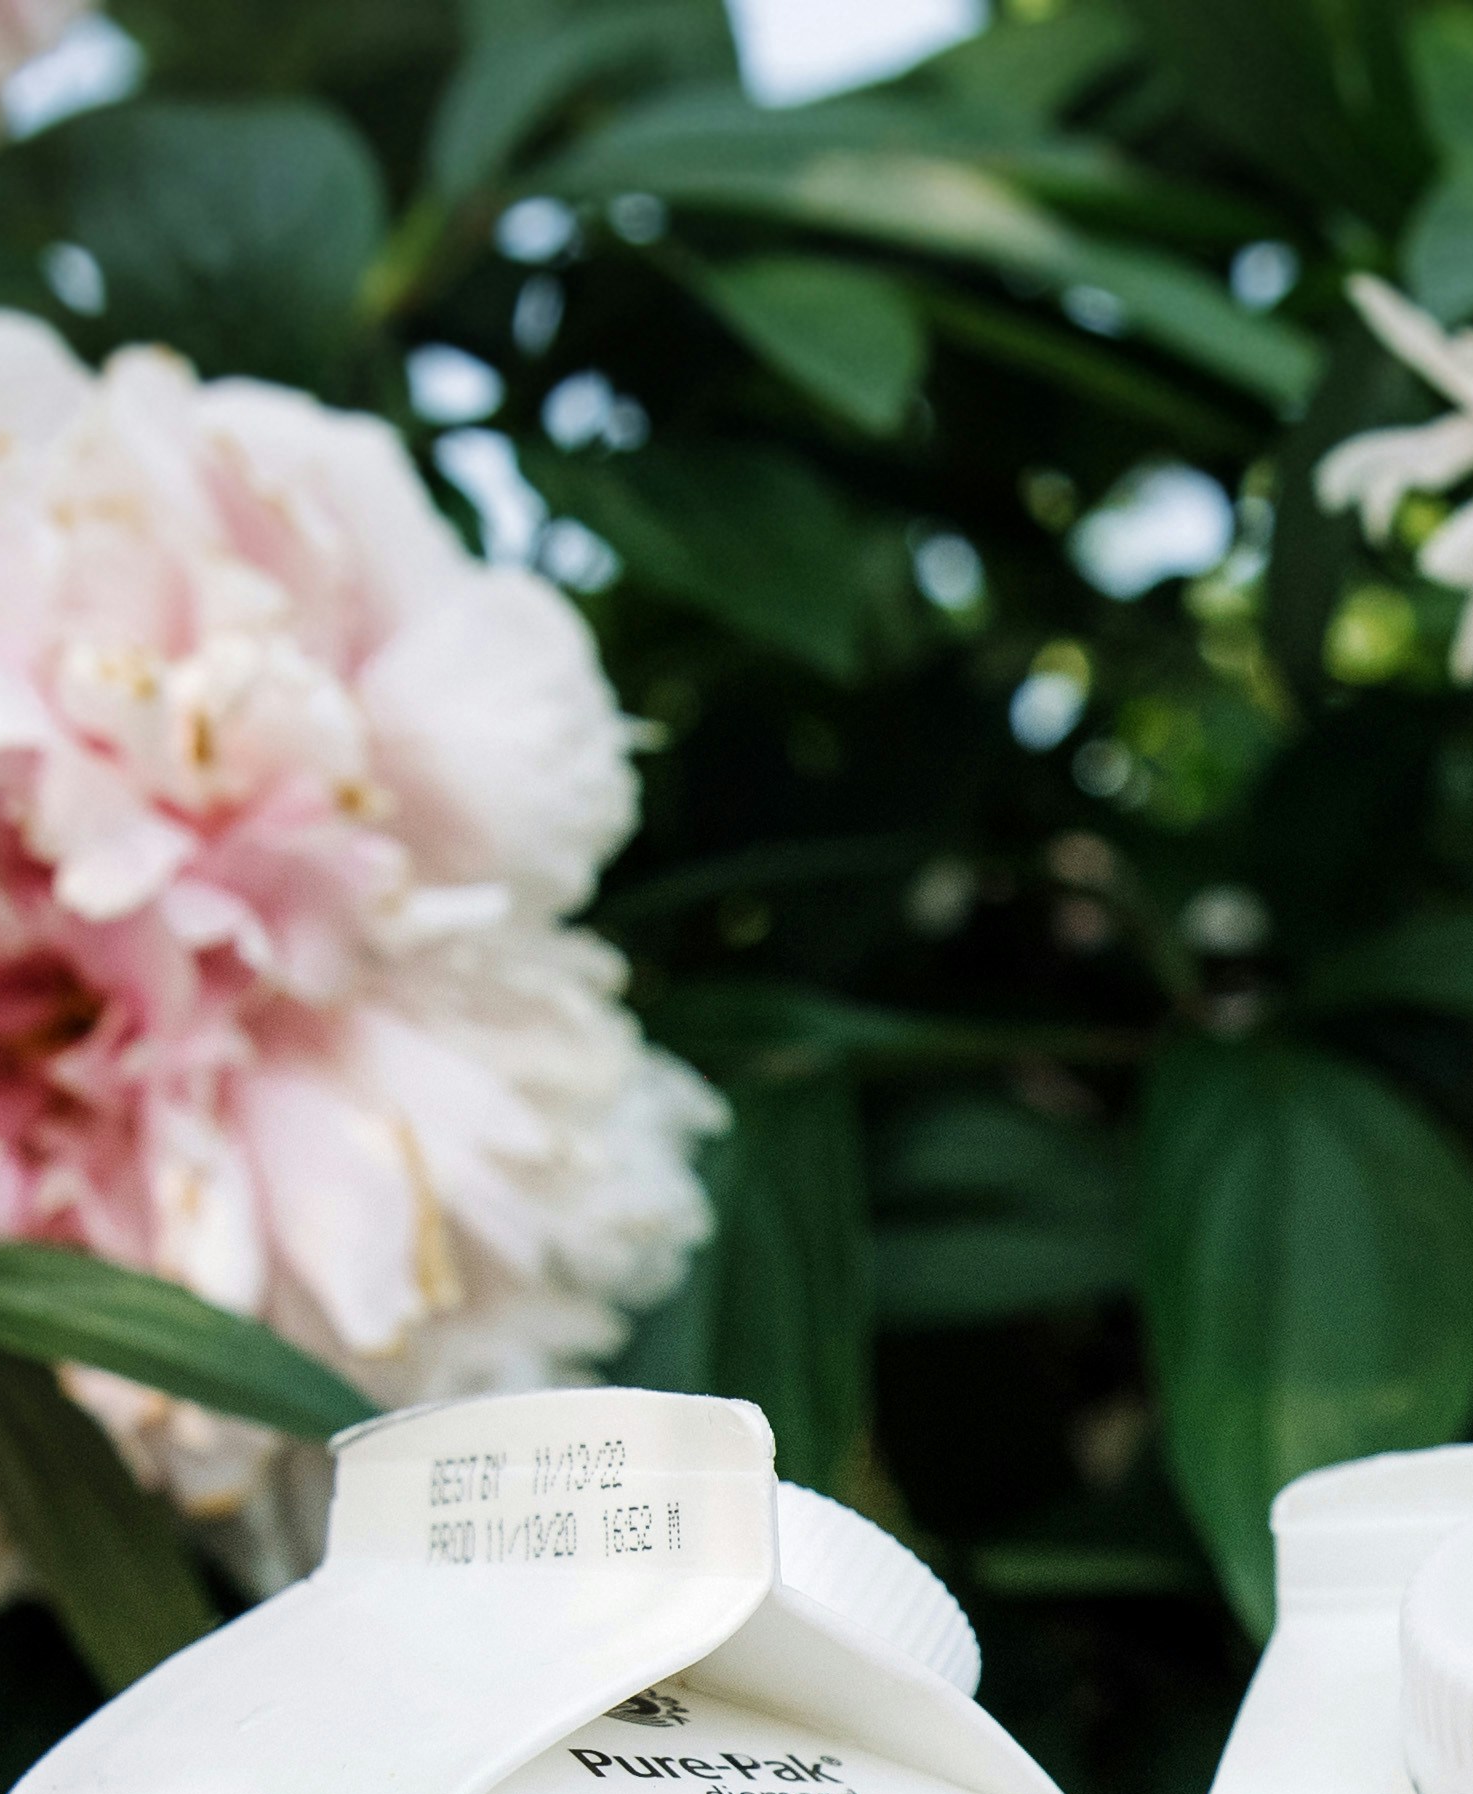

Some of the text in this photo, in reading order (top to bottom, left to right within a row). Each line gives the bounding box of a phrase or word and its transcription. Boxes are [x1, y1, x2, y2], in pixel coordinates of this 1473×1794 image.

[430, 1440, 625, 1506] BEST BY 11/13/22
[428, 1519, 477, 1564] PROD
[485, 1511, 577, 1563] 11/13/20
